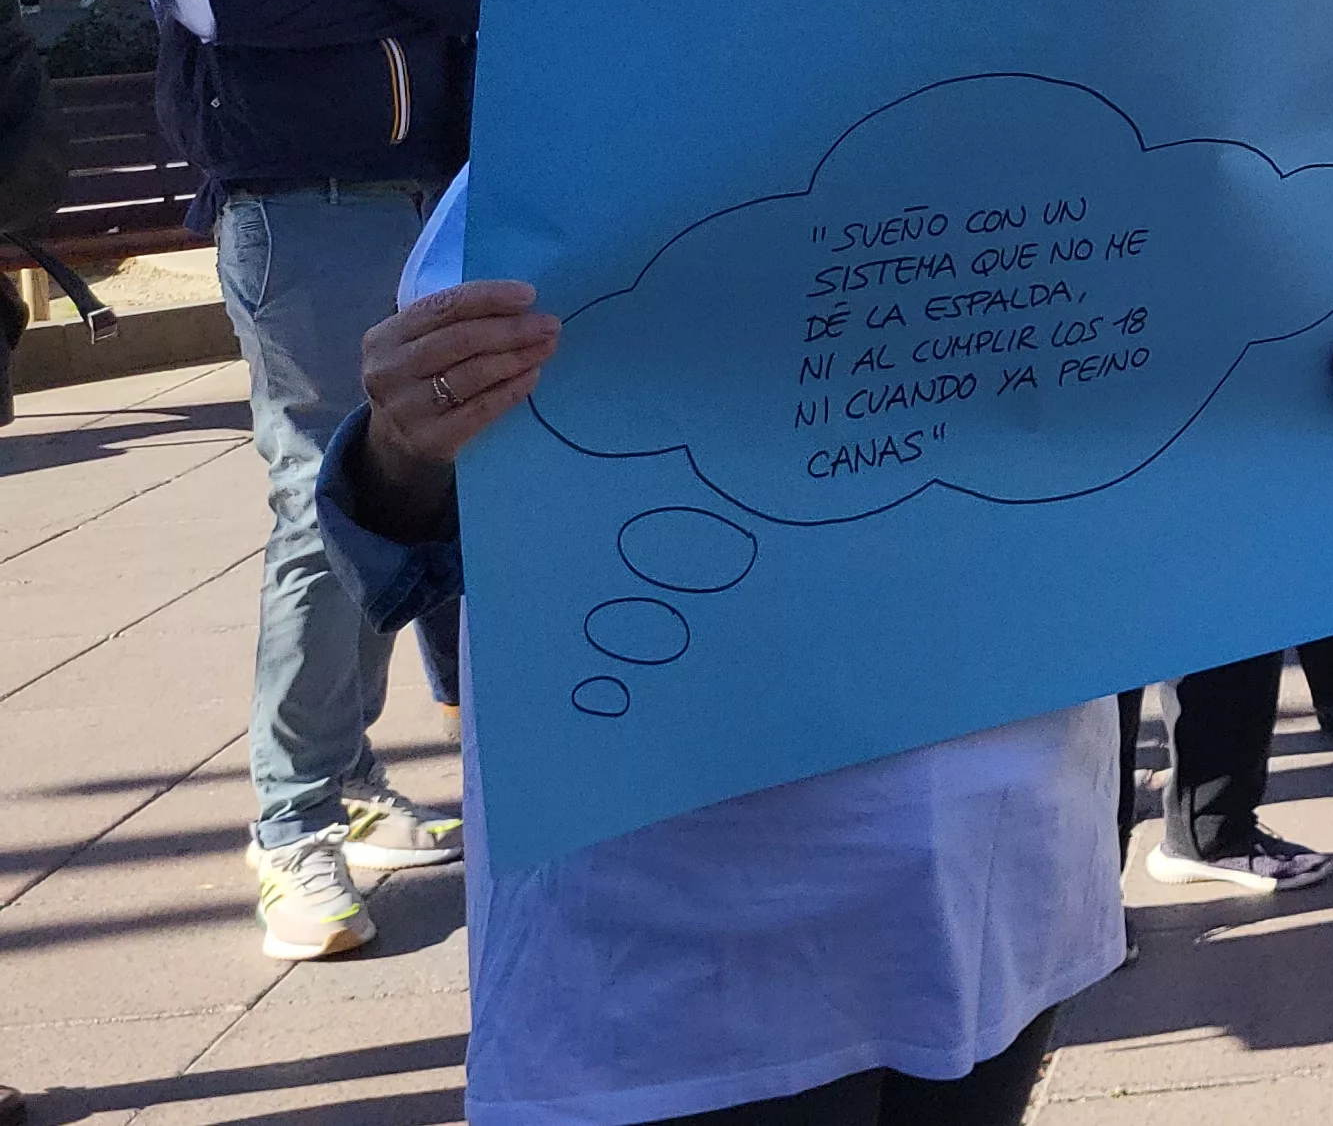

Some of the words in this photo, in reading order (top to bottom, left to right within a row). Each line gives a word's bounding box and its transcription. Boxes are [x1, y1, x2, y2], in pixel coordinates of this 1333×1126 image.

[812, 205, 948, 252] "SUEÑO
[965, 205, 1027, 234] CON
[1043, 196, 1086, 223] UN
[806, 253, 957, 298] SISTEMA
[971, 243, 1038, 277] QUE
[1050, 240, 1092, 265] NO
[1106, 229, 1149, 260] ME
[804, 302, 851, 342] DÉ
[866, 305, 907, 328] LA
[924, 280, 1087, 322] ESPALDA,
[800, 353, 835, 384] NI
[851, 345, 895, 371] AL
[912, 325, 1036, 362] CUMPLIR
[1050, 316, 1104, 348] LOS
[1113, 306, 1149, 336] 18
[794, 396, 830, 429] NI
[845, 373, 977, 419] CUANDO
[997, 367, 1038, 396] YA
[1058, 347, 1150, 387] PEINO
[806, 422, 947, 479] CANAS"
